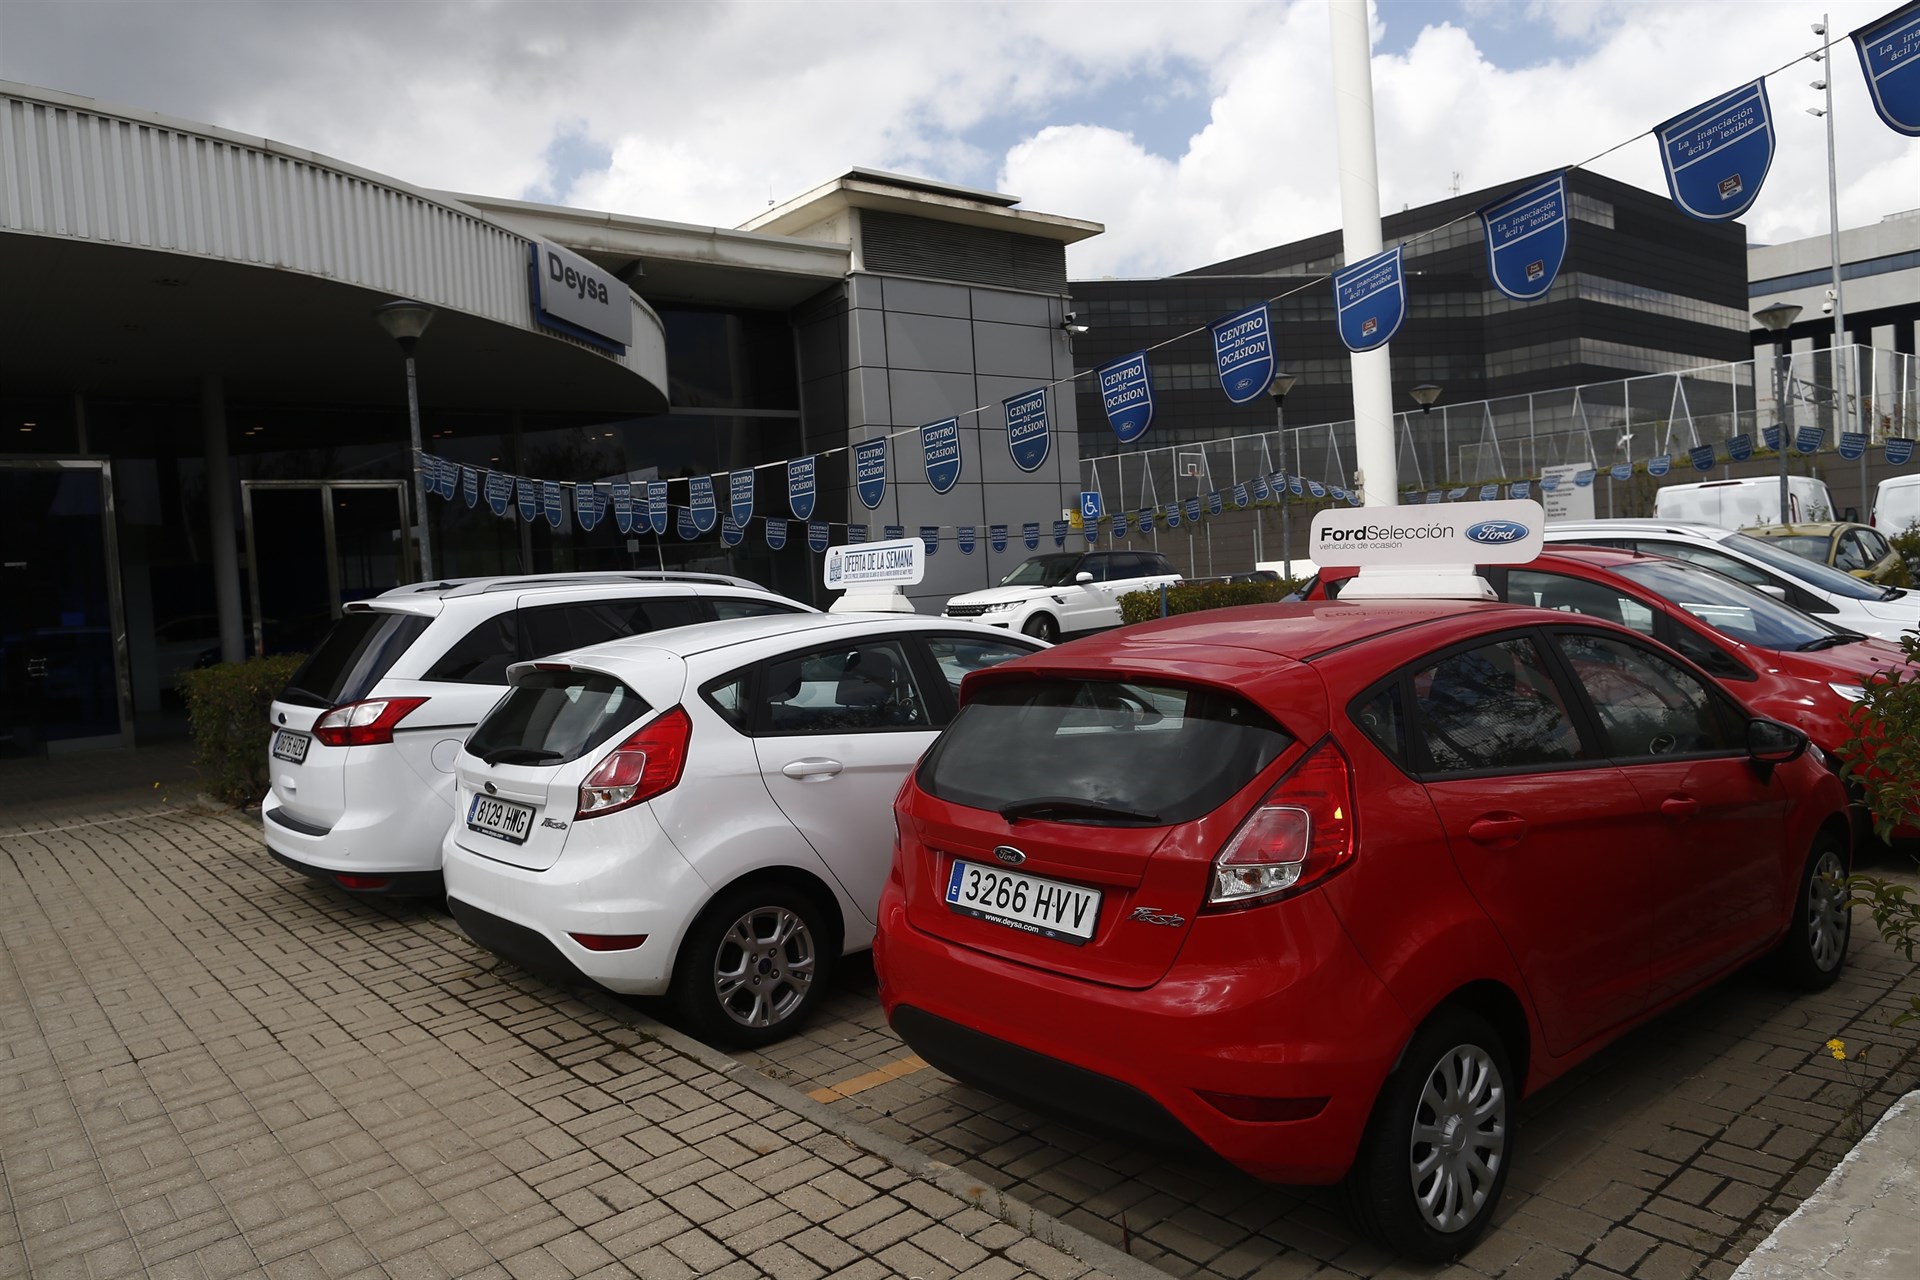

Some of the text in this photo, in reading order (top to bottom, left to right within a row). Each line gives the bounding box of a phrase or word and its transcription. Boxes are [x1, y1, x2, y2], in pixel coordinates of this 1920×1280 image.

[1880, 44, 1892, 56] La
[1678, 140, 1690, 151] La
[1706, 139, 1713, 148] y
[548, 251, 608, 305] Deysa
[1220, 318, 1263, 343] CENTRO
[1235, 337, 1246, 347] DE
[1221, 341, 1266, 366] OCASION
[1104, 365, 1140, 386] CENTRO
[1118, 383, 1127, 391] DE
[1107, 387, 1144, 408] OCASION
[1010, 399, 1042, 417] CENTRO
[925, 426, 954, 442] CENTRO
[1012, 420, 1044, 437] OCASION
[859, 447, 884, 460] CENTRO
[927, 446, 956, 460] OCASION
[790, 463, 812, 475] CENTRO
[859, 466, 884, 477] OCASION
[692, 482, 711, 490] CENTRO
[732, 475, 752, 485] CENTRO
[791, 480, 813, 491] OCASION
[1320, 524, 1515, 541] FordSelección Ford
[845, 554, 866, 572] OFERTA
[868, 553, 875, 570] DE
[877, 552, 884, 569] LA
[886, 549, 912, 569] SEMANA
[477, 801, 503, 827] 8129
[999, 850, 1016, 861] Ford
[951, 886, 958, 895] E
[966, 870, 1090, 928] 3266 HVV
[985, 914, 1039, 933] www.deysa.com
